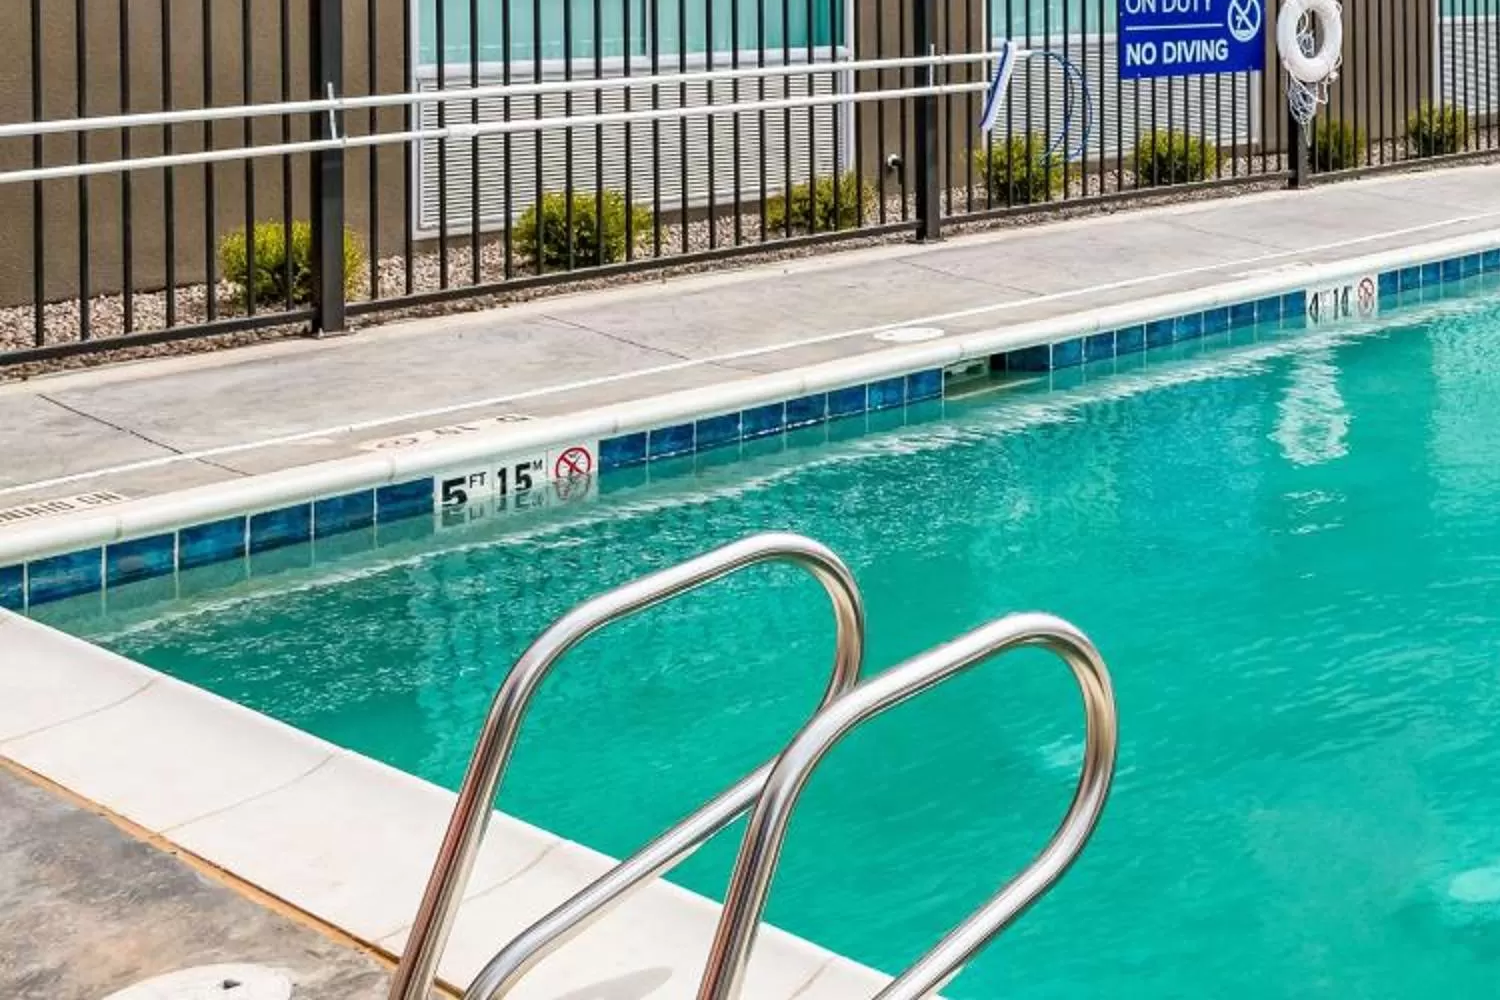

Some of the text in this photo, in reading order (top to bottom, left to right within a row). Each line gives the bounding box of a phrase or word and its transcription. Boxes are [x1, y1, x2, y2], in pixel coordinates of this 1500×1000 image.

[1126, 38, 1229, 67] NO DIVING
[441, 477, 468, 508] 5
